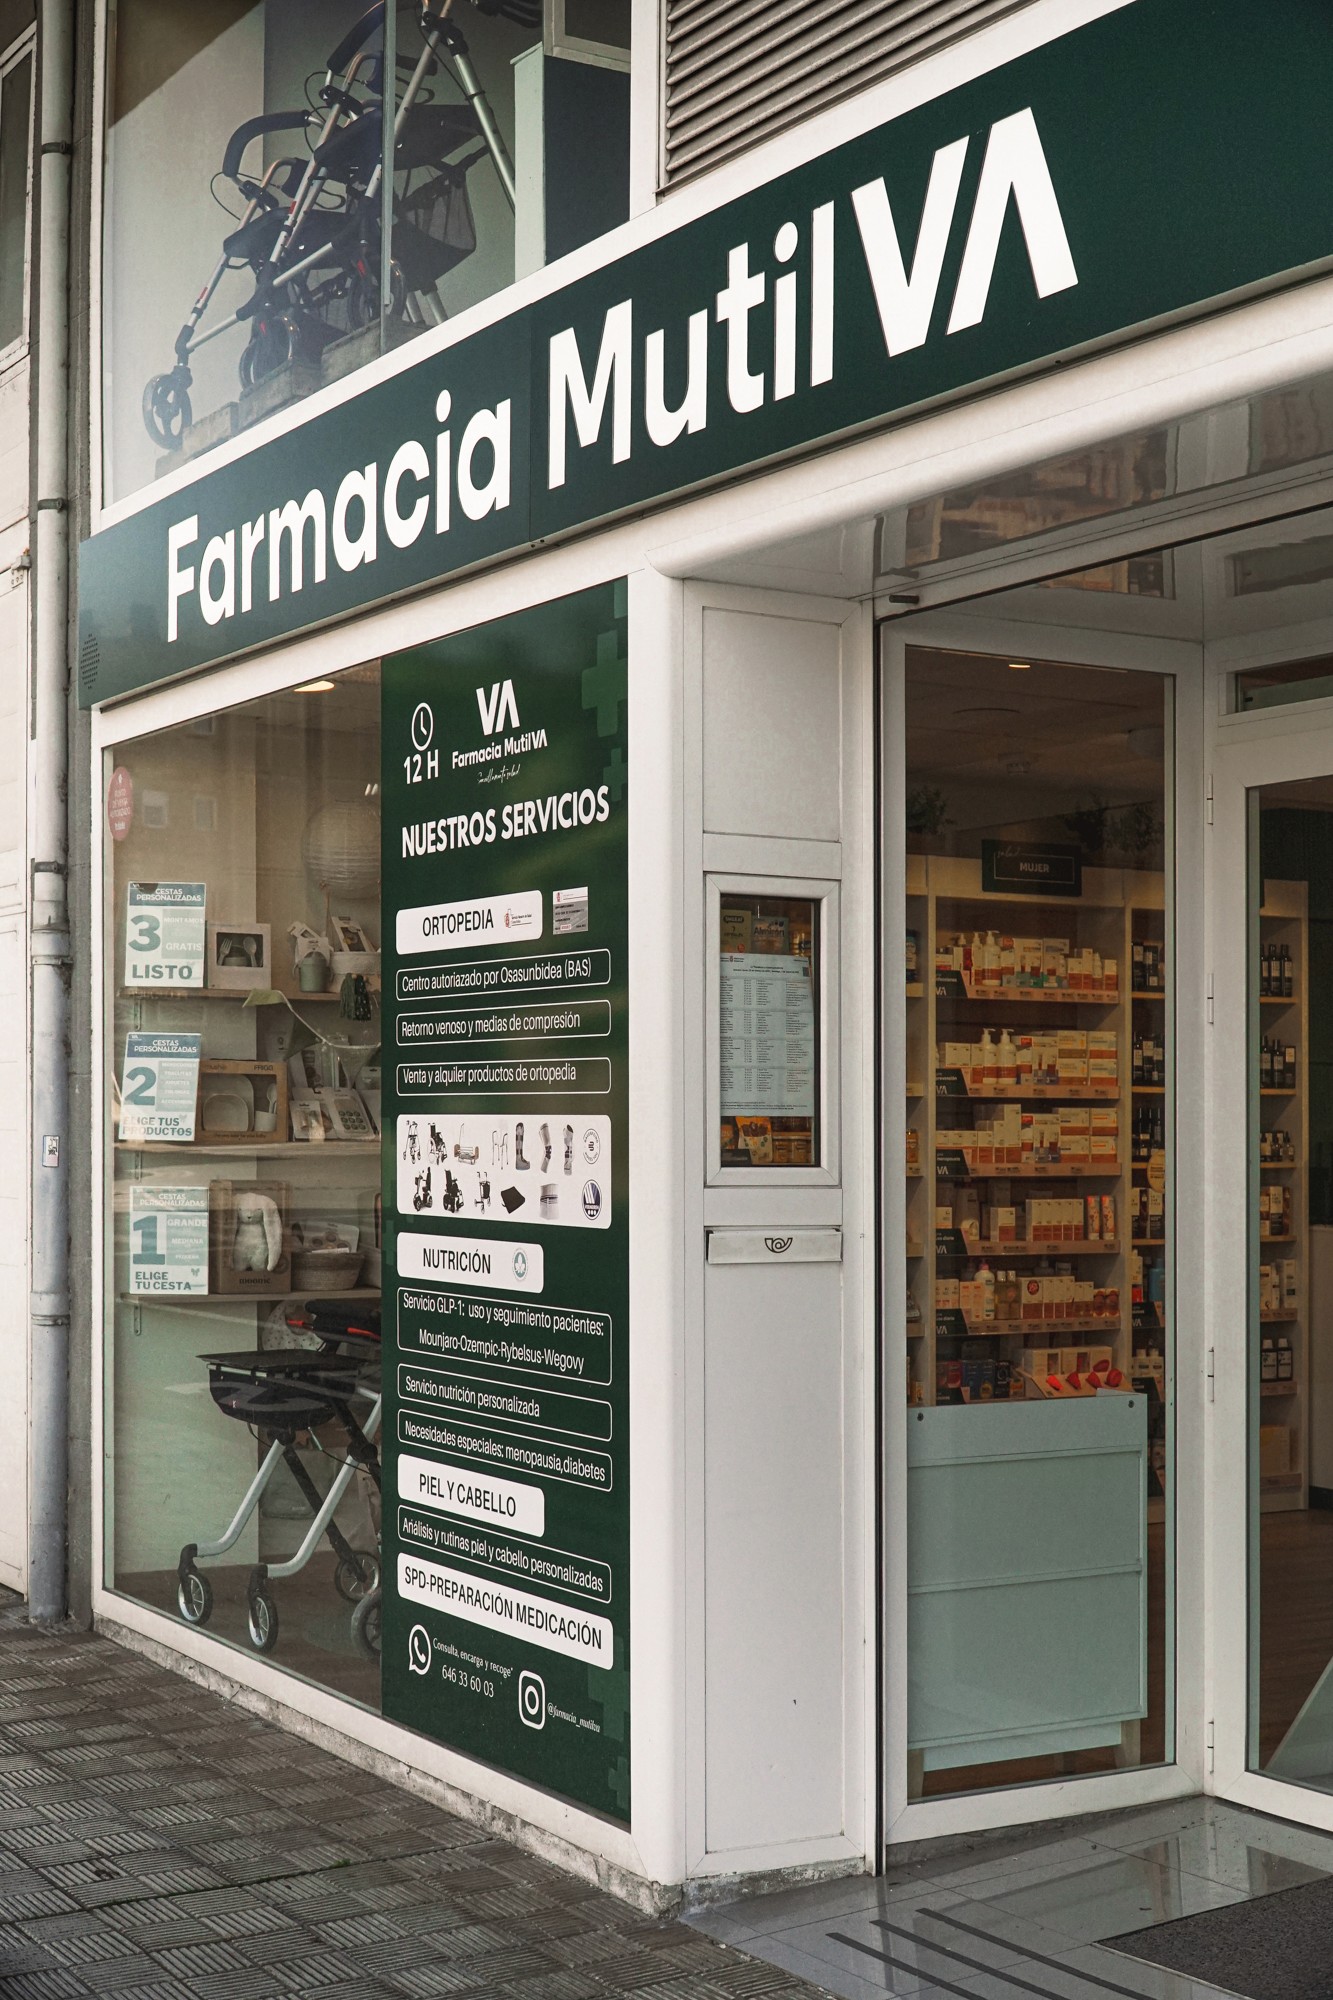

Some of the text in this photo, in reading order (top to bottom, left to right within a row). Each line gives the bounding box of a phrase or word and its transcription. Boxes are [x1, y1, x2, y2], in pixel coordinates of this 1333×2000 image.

[166, 106, 1079, 643] Farmacia MutilVA
[476, 679, 520, 735] VA
[452, 729, 548, 770] Farmacia MutilVA
[403, 750, 439, 784] 12 H
[402, 785, 610, 858] NUESTROS SERVICIOS
[1019, 862, 1051, 873] MUJER
[136, 893, 202, 902] PERSONALIZADAS
[155, 888, 183, 896] CESTAS
[128, 914, 161, 952] 3
[422, 908, 494, 937] ORTOPEDIA
[165, 942, 202, 952] GRATIS
[132, 964, 193, 980] LISTO
[402, 957, 591, 992] Centro autoriazado por Osasunbidea (BAS)
[402, 1011, 581, 1038] Retorno venoso y medias de compresión
[134, 1045, 197, 1053] PERSONALIZADAS
[152, 1039, 179, 1047] CESTAS
[124, 1066, 157, 1106] 2
[403, 1063, 577, 1087] Venta y alquiler productos de ortopedia
[122, 1126, 193, 1137] PRODUCTOS
[158, 1117, 180, 1127] TUS
[936, 1166, 949, 1175] VA
[140, 1199, 206, 1208] PERSONALIZADAS
[158, 1193, 187, 1201] CESTAS
[167, 1218, 208, 1228] GRANDE
[132, 1215, 166, 1265] 1
[171, 1237, 204, 1245] MEDIANA
[423, 1248, 491, 1274] NUTRICIÓN
[135, 1271, 169, 1281] ELIGE
[135, 1281, 192, 1291] TU CESTA
[403, 1293, 604, 1336] Servicio GLP-1: uso y seguimiento pacientes:
[405, 1376, 540, 1417] Servicio nutrición personalizada
[405, 1420, 456, 1446] Necesidades
[458, 1434, 504, 1458] especiales:
[419, 1473, 516, 1517] PIEL Y CABELLO
[434, 1530, 440, 1545] y
[441, 1530, 470, 1551] rutinas
[471, 1538, 488, 1557] piel
[488, 1545, 494, 1562] y
[495, 1546, 529, 1569] cabello
[530, 1558, 604, 1592] personalizadas
[405, 1565, 602, 1650] SPD-PREPARACIÓN MEDICACIÓN
[433, 1638, 459, 1658] Consulta,
[460, 1651, 484, 1668] encarga
[485, 1658, 489, 1671] y
[441, 1665, 494, 1698] 646 33 60 03
